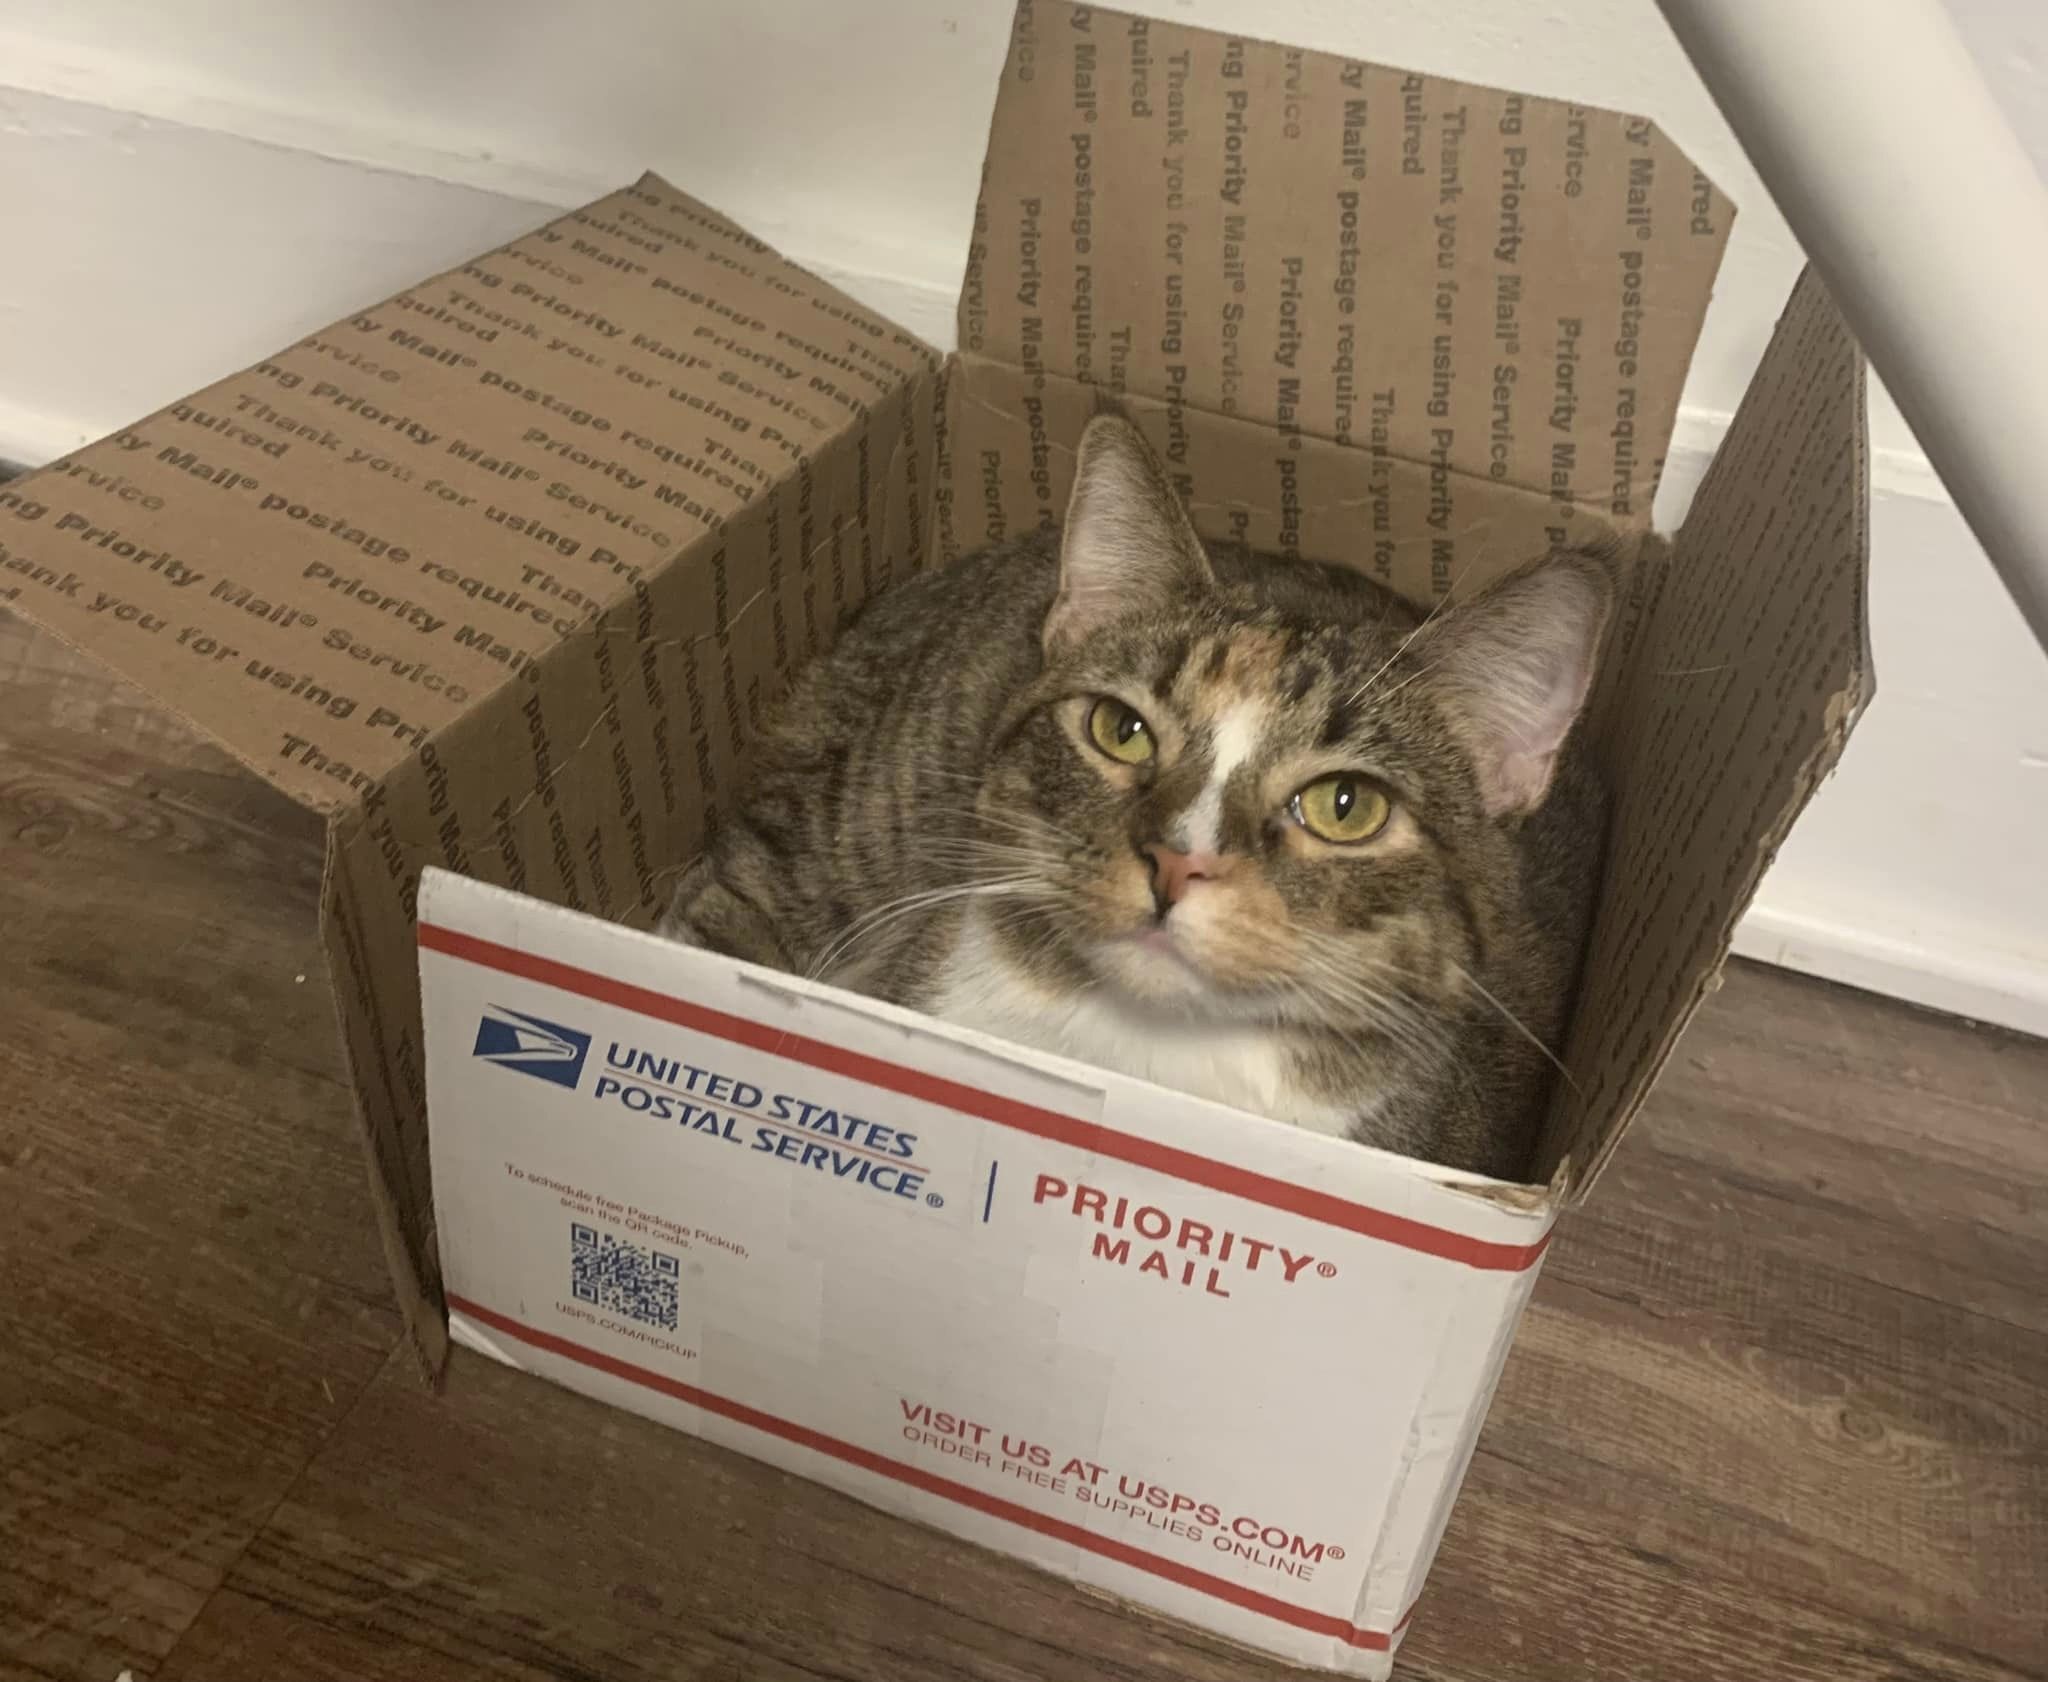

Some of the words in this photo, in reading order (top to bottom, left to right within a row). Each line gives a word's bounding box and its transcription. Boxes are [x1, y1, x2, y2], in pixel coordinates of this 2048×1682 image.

[1128, 18, 1153, 118] quired
[1168, 49, 1190, 147] Thank
[1220, 91, 1248, 206] Priority
[1401, 74, 1427, 175] quired
[1440, 106, 1466, 204] Thank
[669, 203, 771, 253] Priority
[1071, 133, 1096, 253] postage
[1162, 156, 1184, 210] you
[1494, 147, 1527, 263] Priority
[618, 209, 700, 250] Thank
[705, 250, 756, 278] you
[811, 298, 885, 336] using
[1017, 198, 1042, 308] Priority
[1166, 222, 1188, 265] for
[1334, 192, 1360, 314] postage
[1434, 215, 1456, 270] you
[651, 277, 767, 331] postage
[776, 330, 892, 395] required
[693, 326, 804, 379] Priority
[1071, 264, 1099, 384] required
[1161, 274, 1187, 354] using
[1275, 257, 1303, 368] Priority
[1435, 280, 1459, 326] for
[1613, 252, 1645, 378] postage
[449, 289, 541, 340] Thank
[547, 337, 606, 367] you
[614, 364, 662, 388] for
[668, 388, 751, 432] using
[510, 283, 626, 338] Priority
[717, 370, 828, 430] Service
[1222, 302, 1244, 412] Service
[1427, 335, 1456, 417] using
[1549, 317, 1582, 432] Priority
[170, 403, 291, 458] quired
[256, 363, 304, 388] ng
[310, 381, 442, 445] Priority
[545, 481, 672, 548] Service
[480, 370, 612, 432] postage
[619, 429, 755, 501] required
[522, 427, 648, 490] Priority
[1022, 397, 1049, 501] postage
[1165, 365, 1190, 465] Priority
[1371, 387, 1395, 476] Thank
[1490, 364, 1518, 478] Service
[1610, 388, 1638, 516] required
[236, 393, 343, 451] Thank
[344, 447, 414, 483] you
[423, 478, 478, 507] for
[484, 505, 582, 556] using
[1368, 484, 1390, 532] you
[1426, 428, 1455, 531] Priority
[0, 491, 49, 521] ng
[54, 511, 205, 587] Priority
[322, 627, 469, 703] Service
[258, 492, 411, 563] postage
[419, 560, 577, 642] required
[302, 559, 447, 633] Priority
[1375, 541, 1396, 579] for
[86, 591, 168, 634] you
[176, 626, 240, 663] for
[245, 659, 360, 719] using
[279, 731, 386, 818] Thank
[594, 1076, 743, 1144] POSTAL
[606, 1042, 763, 1109] UNITED
[767, 1094, 918, 1158] STATES
[504, 1162, 524, 1180] To
[528, 1172, 592, 1203] schedule
[596, 1195, 625, 1213] free
[628, 1206, 690, 1238] Package
[695, 1229, 750, 1259] Pickup,
[560, 1197, 594, 1215] scan
[598, 1208, 621, 1226] the
[625, 1218, 649, 1234] QR
[652, 1228, 693, 1250] code.
[1092, 1232, 1230, 1298] MAIL
[556, 1301, 698, 1360] USPS.COM/PICKUP
[900, 1398, 991, 1445] VISIT
[1001, 1435, 1052, 1468] US
[1060, 1458, 1109, 1486] AT
[903, 1426, 992, 1468] ORDER
[1001, 1460, 1067, 1495] FREE
[1075, 1486, 1203, 1542] SUPPLIES
[1212, 1535, 1315, 1582] ONLINE
